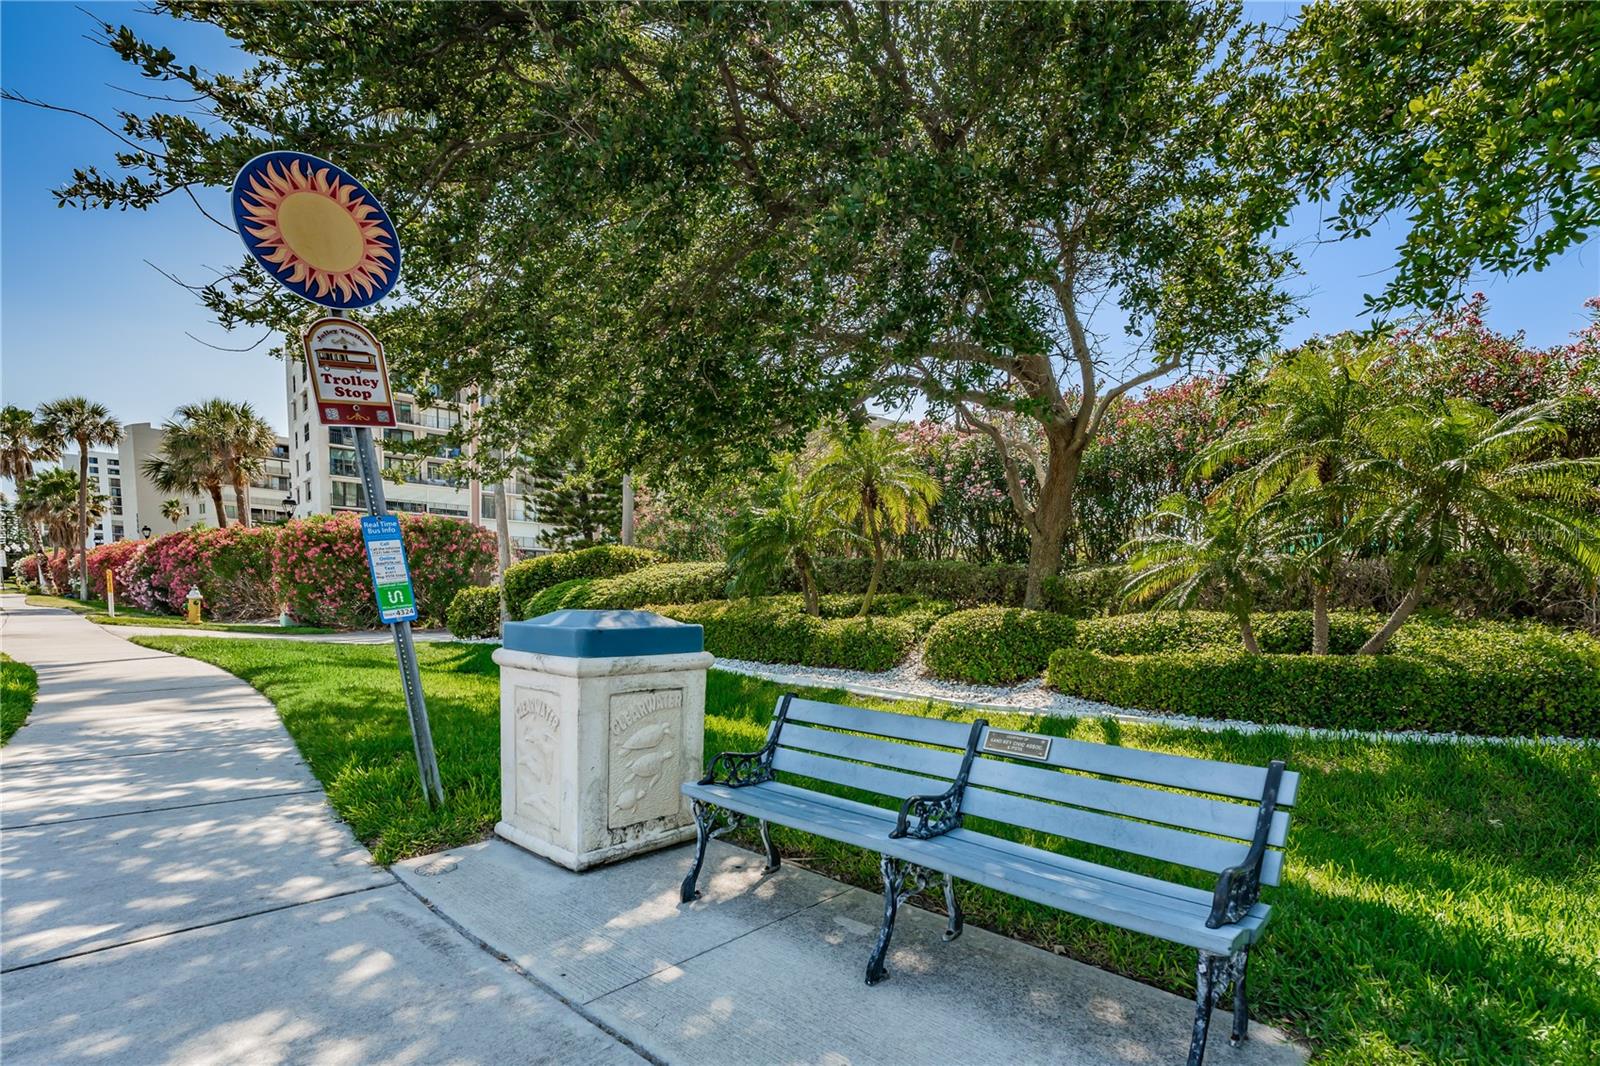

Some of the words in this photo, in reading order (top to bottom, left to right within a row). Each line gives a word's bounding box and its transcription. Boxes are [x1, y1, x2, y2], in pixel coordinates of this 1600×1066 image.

[321, 373, 379, 389] Trolley
[335, 386, 372, 400] Stop
[396, 608, 414, 616] 4324
[612, 694, 682, 736] CLEARWATER
